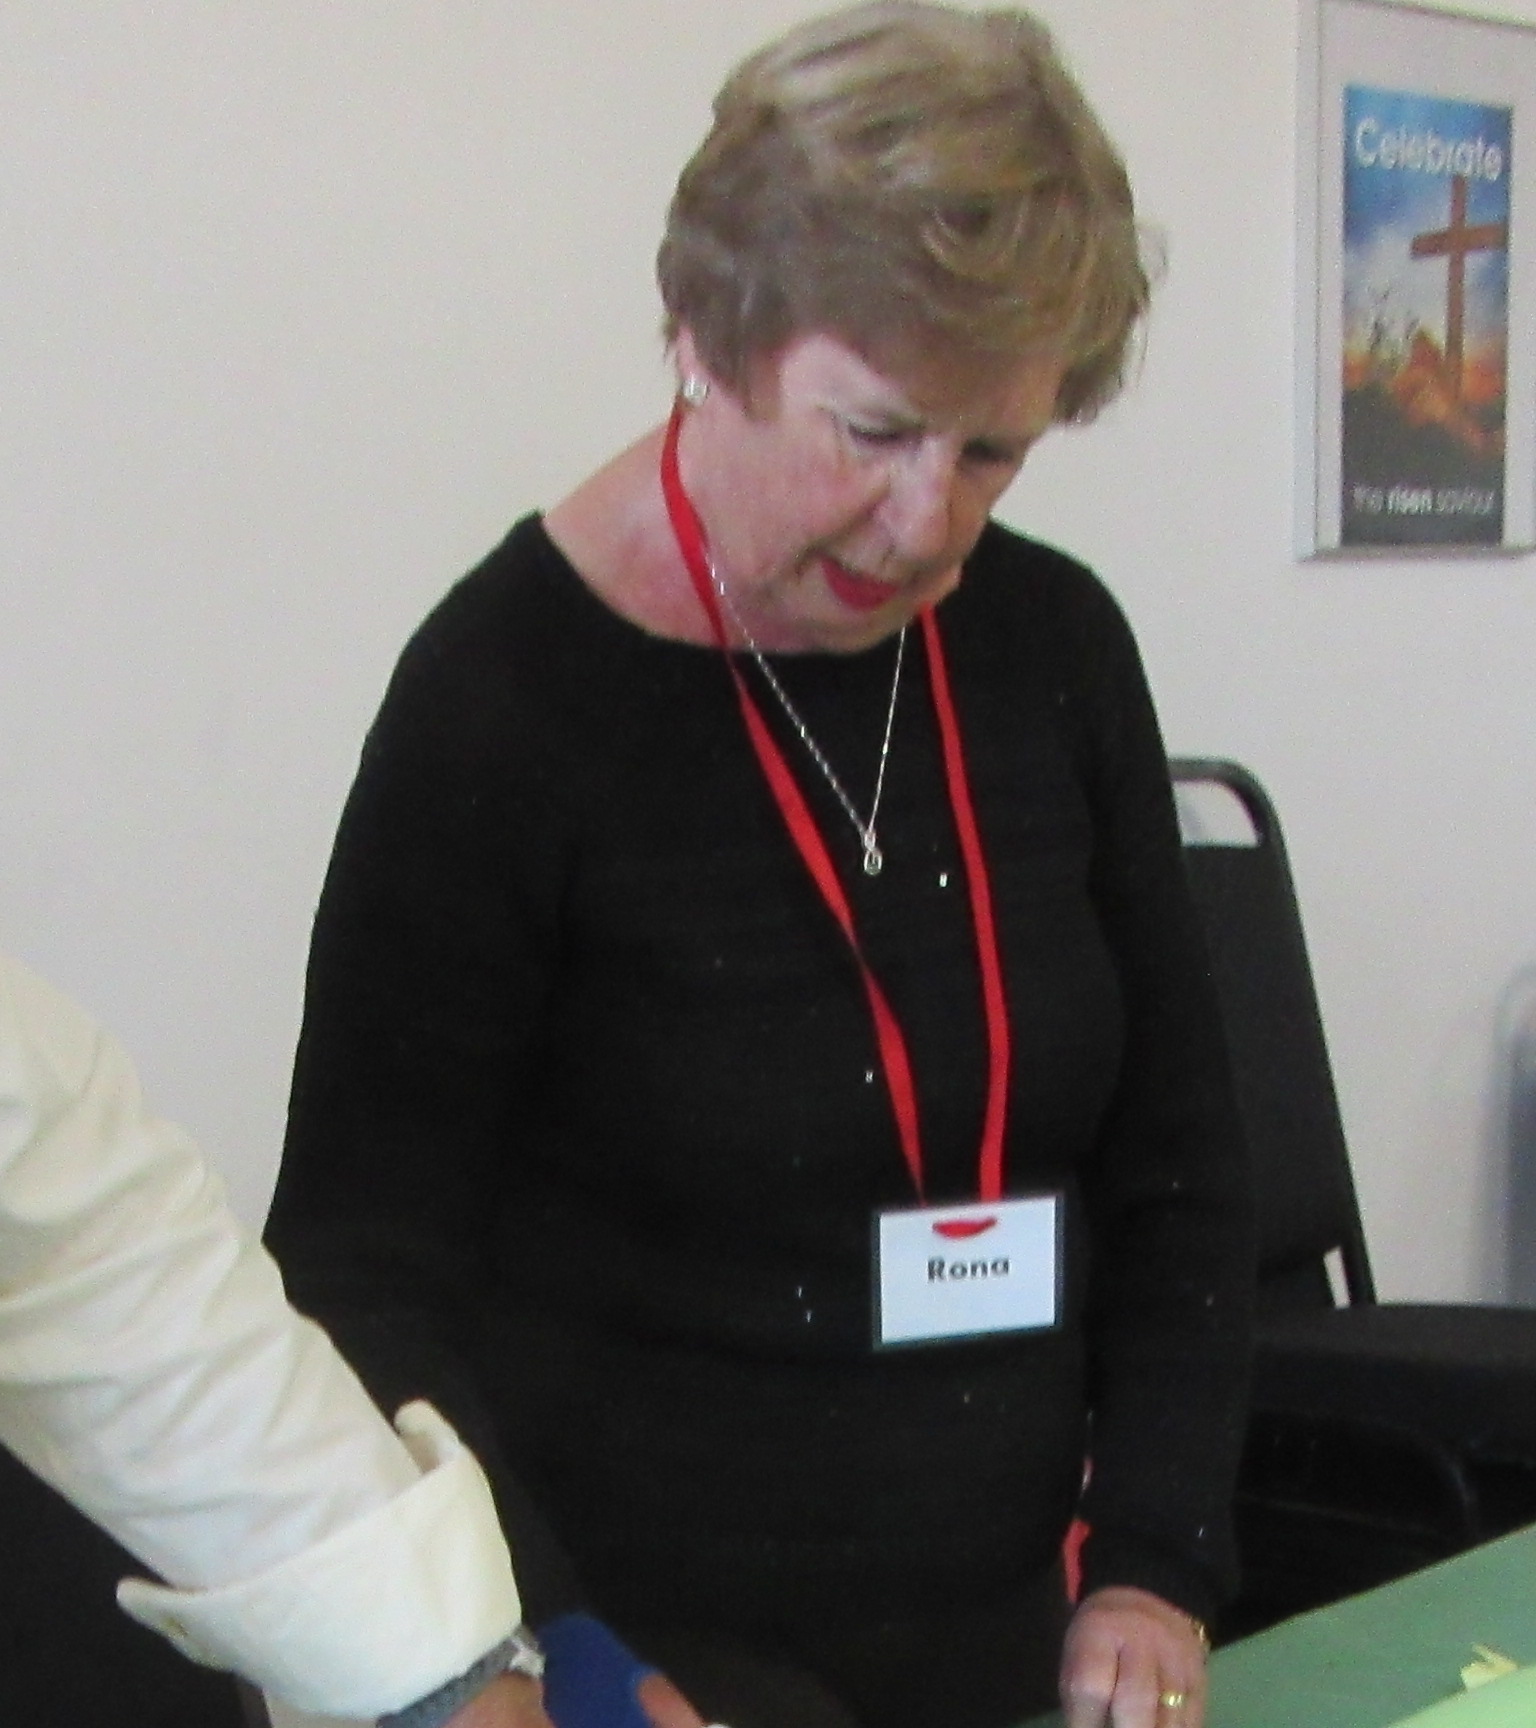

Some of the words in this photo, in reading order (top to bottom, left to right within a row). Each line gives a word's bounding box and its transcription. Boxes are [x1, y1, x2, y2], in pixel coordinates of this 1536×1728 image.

[1355, 117, 1502, 182] Celebrate
[1388, 484, 1432, 516] risen
[927, 1255, 1010, 1284] Rona
